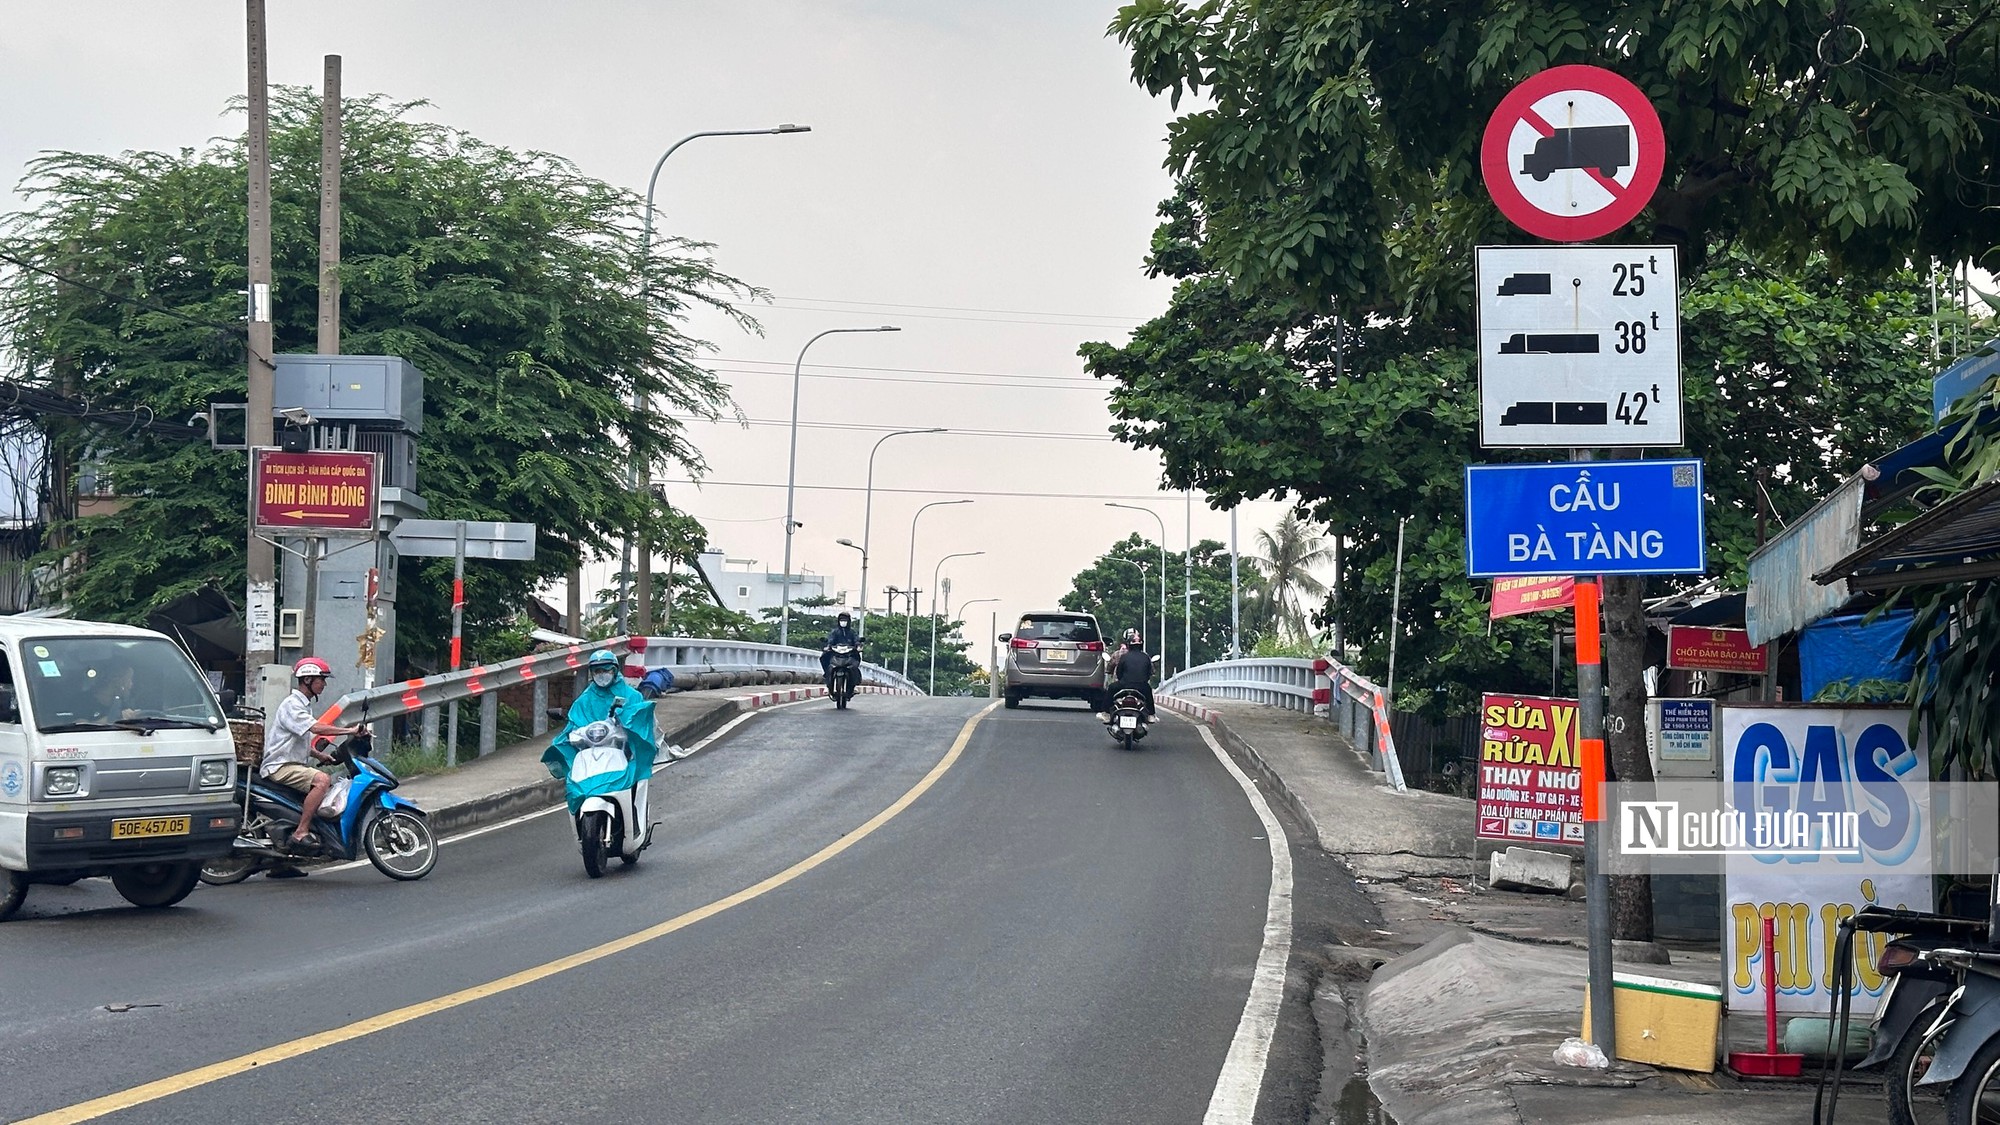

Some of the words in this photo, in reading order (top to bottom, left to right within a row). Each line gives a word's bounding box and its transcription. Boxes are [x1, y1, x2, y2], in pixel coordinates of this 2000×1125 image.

[265, 479, 295, 504] ĐÌNH
[298, 480, 328, 506] BÌNH
[331, 481, 365, 507] ĐÔNG
[1508, 524, 1557, 562] BÀ
[1565, 522, 1664, 561] TÀNG
[1676, 646, 1699, 656] CHỐT
[1699, 648, 1718, 658] ĐẢM
[1720, 648, 1737, 658] BẢO
[1738, 652, 1760, 660] ANTT
[1486, 700, 1547, 730] SỬA
[1484, 735, 1545, 765] RỬA
[1483, 766, 1532, 786] THAY
[1481, 785, 1496, 800] BẢO
[1520, 790, 1530, 802] XE
[1536, 792, 1546, 804] TAY
[1570, 796, 1580, 806] XE
[1733, 722, 1917, 860] GAS
[119, 819, 184, 835] 50E-457.05
[1514, 808, 1543, 820] REMAP
[1732, 902, 1813, 990] PHI
[1820, 879, 1907, 991] HÒ
